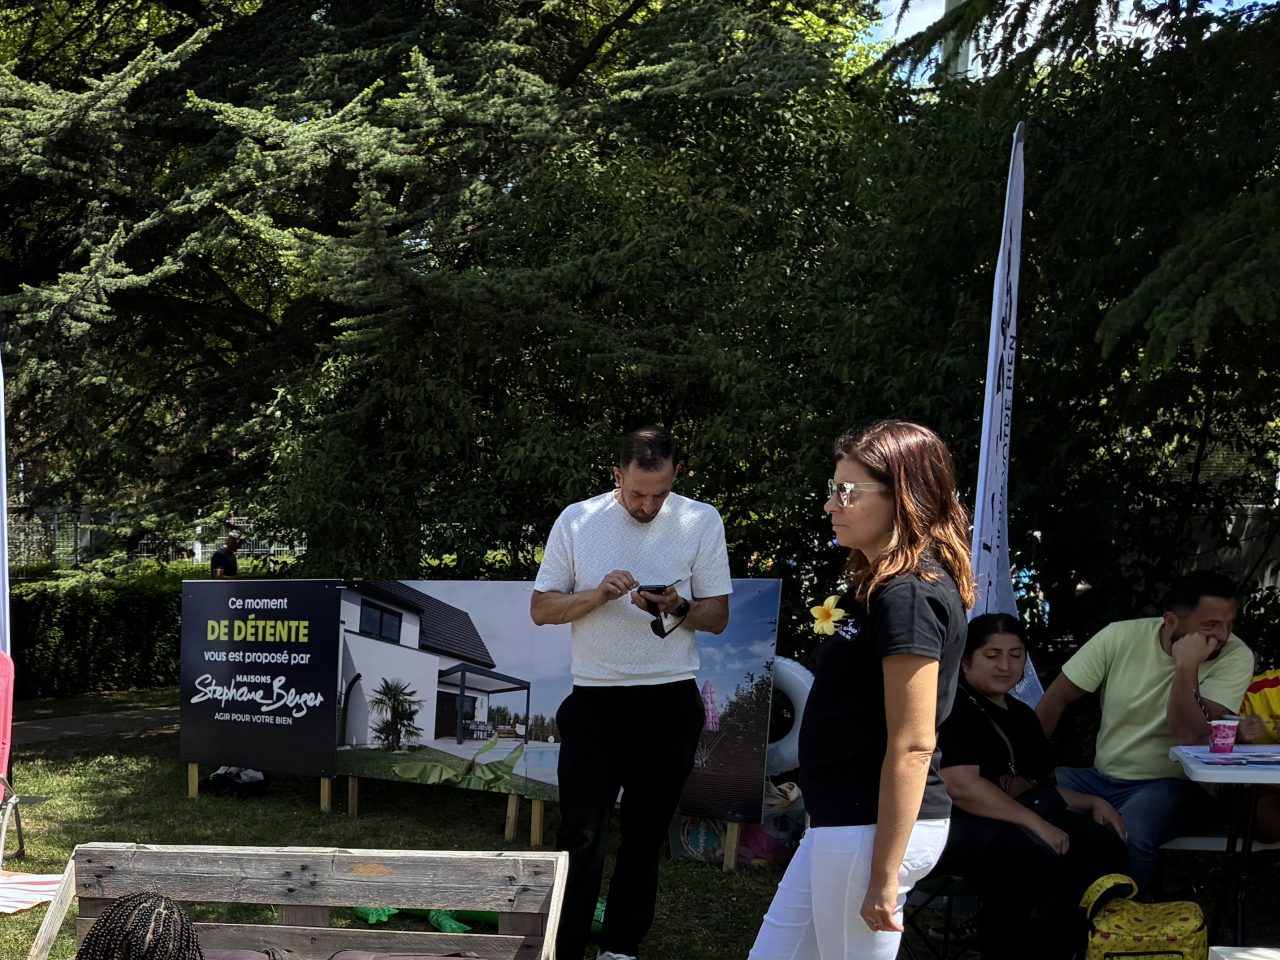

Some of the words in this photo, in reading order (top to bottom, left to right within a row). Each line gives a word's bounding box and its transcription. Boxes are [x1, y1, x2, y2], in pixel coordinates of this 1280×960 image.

[228, 597, 243, 609] Ce
[244, 597, 288, 609] moment
[207, 620, 229, 640] DE
[233, 614, 309, 642] DÉTENTE
[204, 651, 227, 661] vous
[228, 651, 243, 661] est
[245, 650, 289, 664] proposé
[291, 653, 311, 665] par
[236, 674, 271, 683] MAISONS
[261, 676, 324, 718] Berger
[214, 712, 230, 720] AGIR
[231, 713, 250, 722] POUR
[252, 714, 274, 724] VOTRE
[275, 716, 292, 725] BIEN
